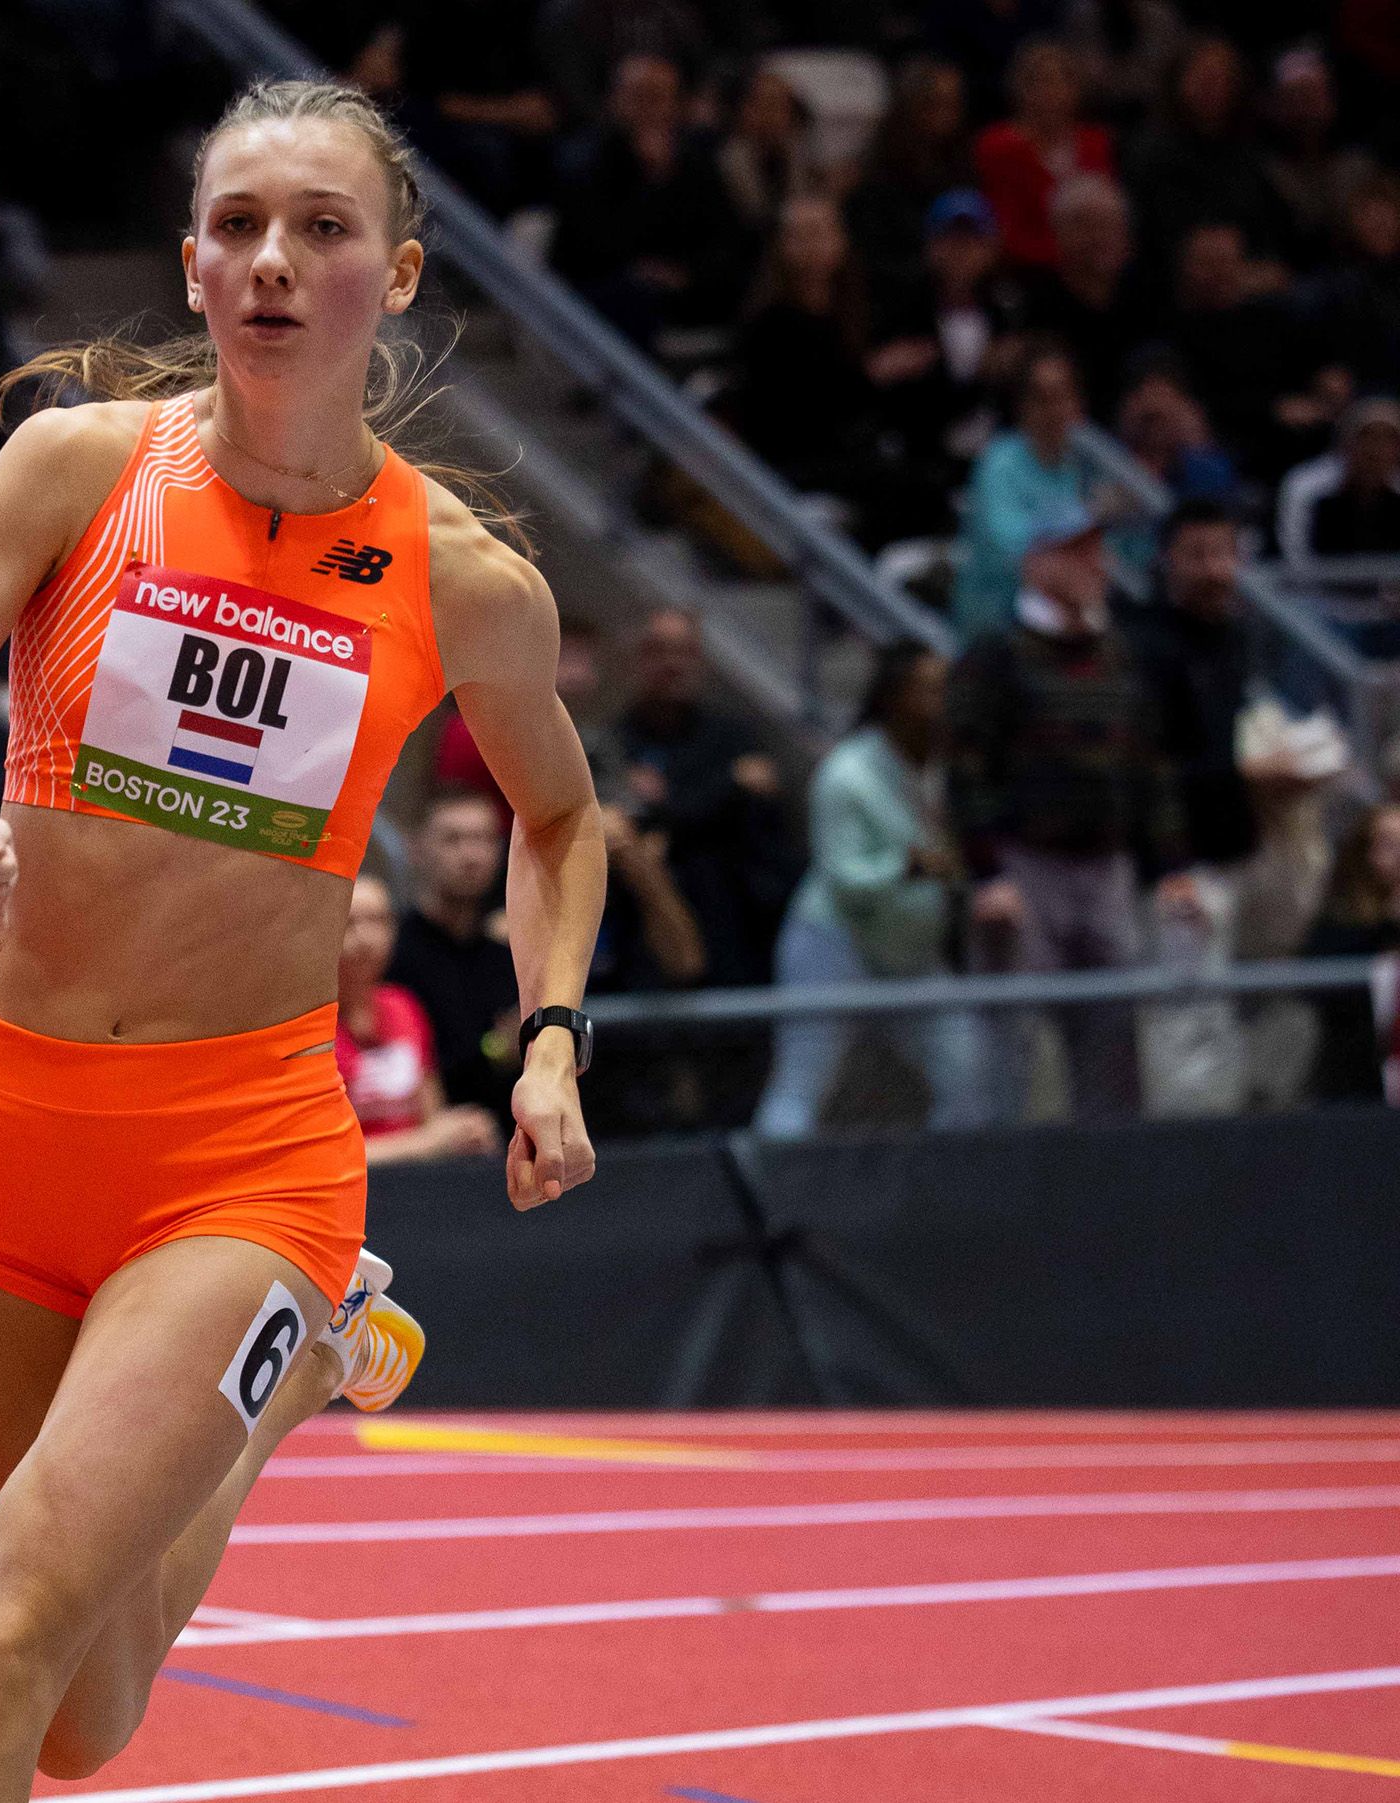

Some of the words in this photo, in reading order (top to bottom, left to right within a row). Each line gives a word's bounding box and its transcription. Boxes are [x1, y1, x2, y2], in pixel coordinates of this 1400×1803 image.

[311, 539, 393, 585] NB
[135, 581, 210, 618] new
[213, 593, 354, 660] balance
[167, 633, 292, 730] BOL
[85, 761, 204, 819] BOSTON
[209, 800, 250, 831] 23
[239, 1307, 299, 1418] 6
